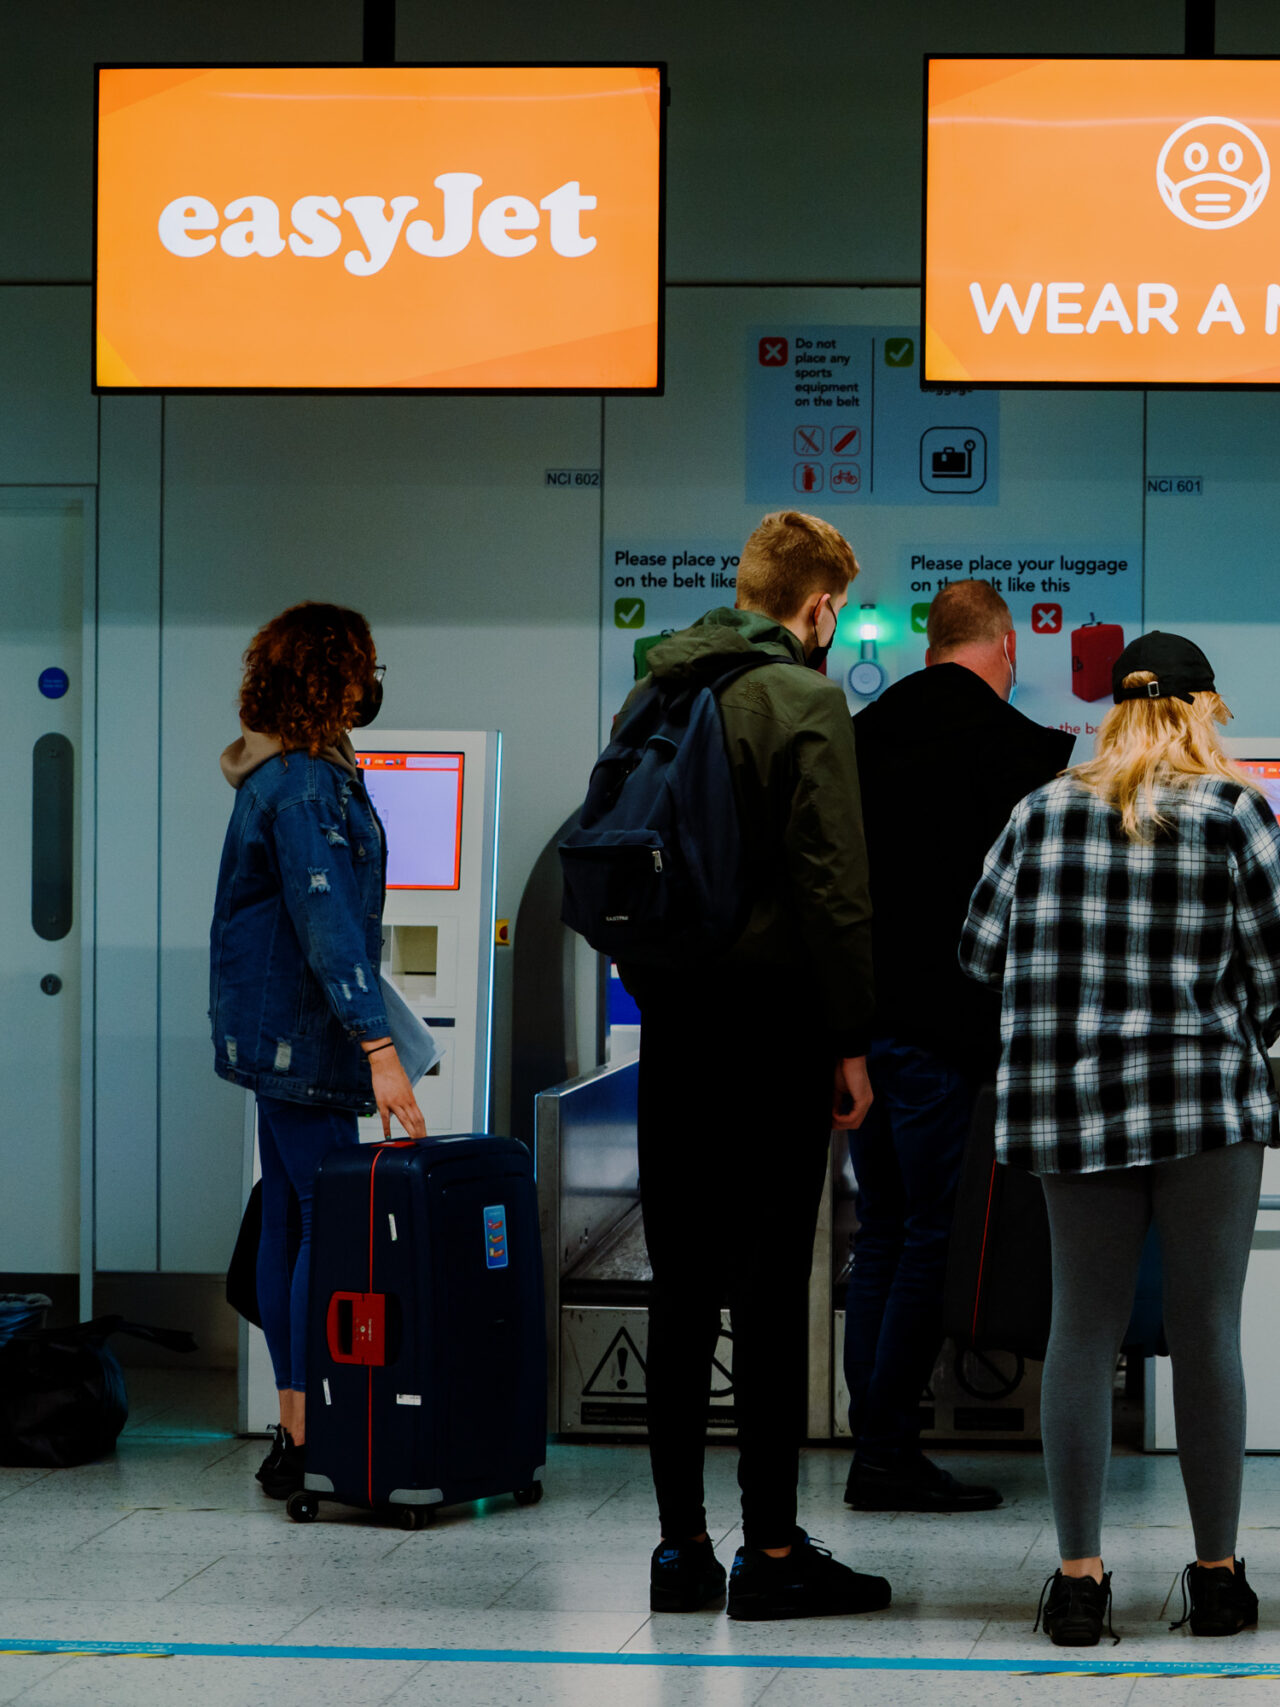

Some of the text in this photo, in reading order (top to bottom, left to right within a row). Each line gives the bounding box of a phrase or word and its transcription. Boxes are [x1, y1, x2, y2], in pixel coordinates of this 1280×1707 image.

[158, 172, 597, 277] easyJet
[969, 282, 1179, 336] WEAR
[1197, 283, 1245, 336] A
[795, 338, 837, 349] Do not
[795, 353, 850, 366] place any
[795, 369, 832, 380] sports
[795, 383, 859, 395] equipment
[795, 396, 860, 407] on the belt
[547, 473, 599, 486] NCI 602
[1147, 480, 1200, 493] NCI 601
[615, 551, 740, 570] Please place yo
[911, 555, 1128, 575] Please place your luggage
[615, 573, 737, 588] on the belt like
[911, 580, 931, 592] on
[1008, 577, 1035, 592] like
[1042, 577, 1071, 592] this
[1059, 722, 1081, 734] the
